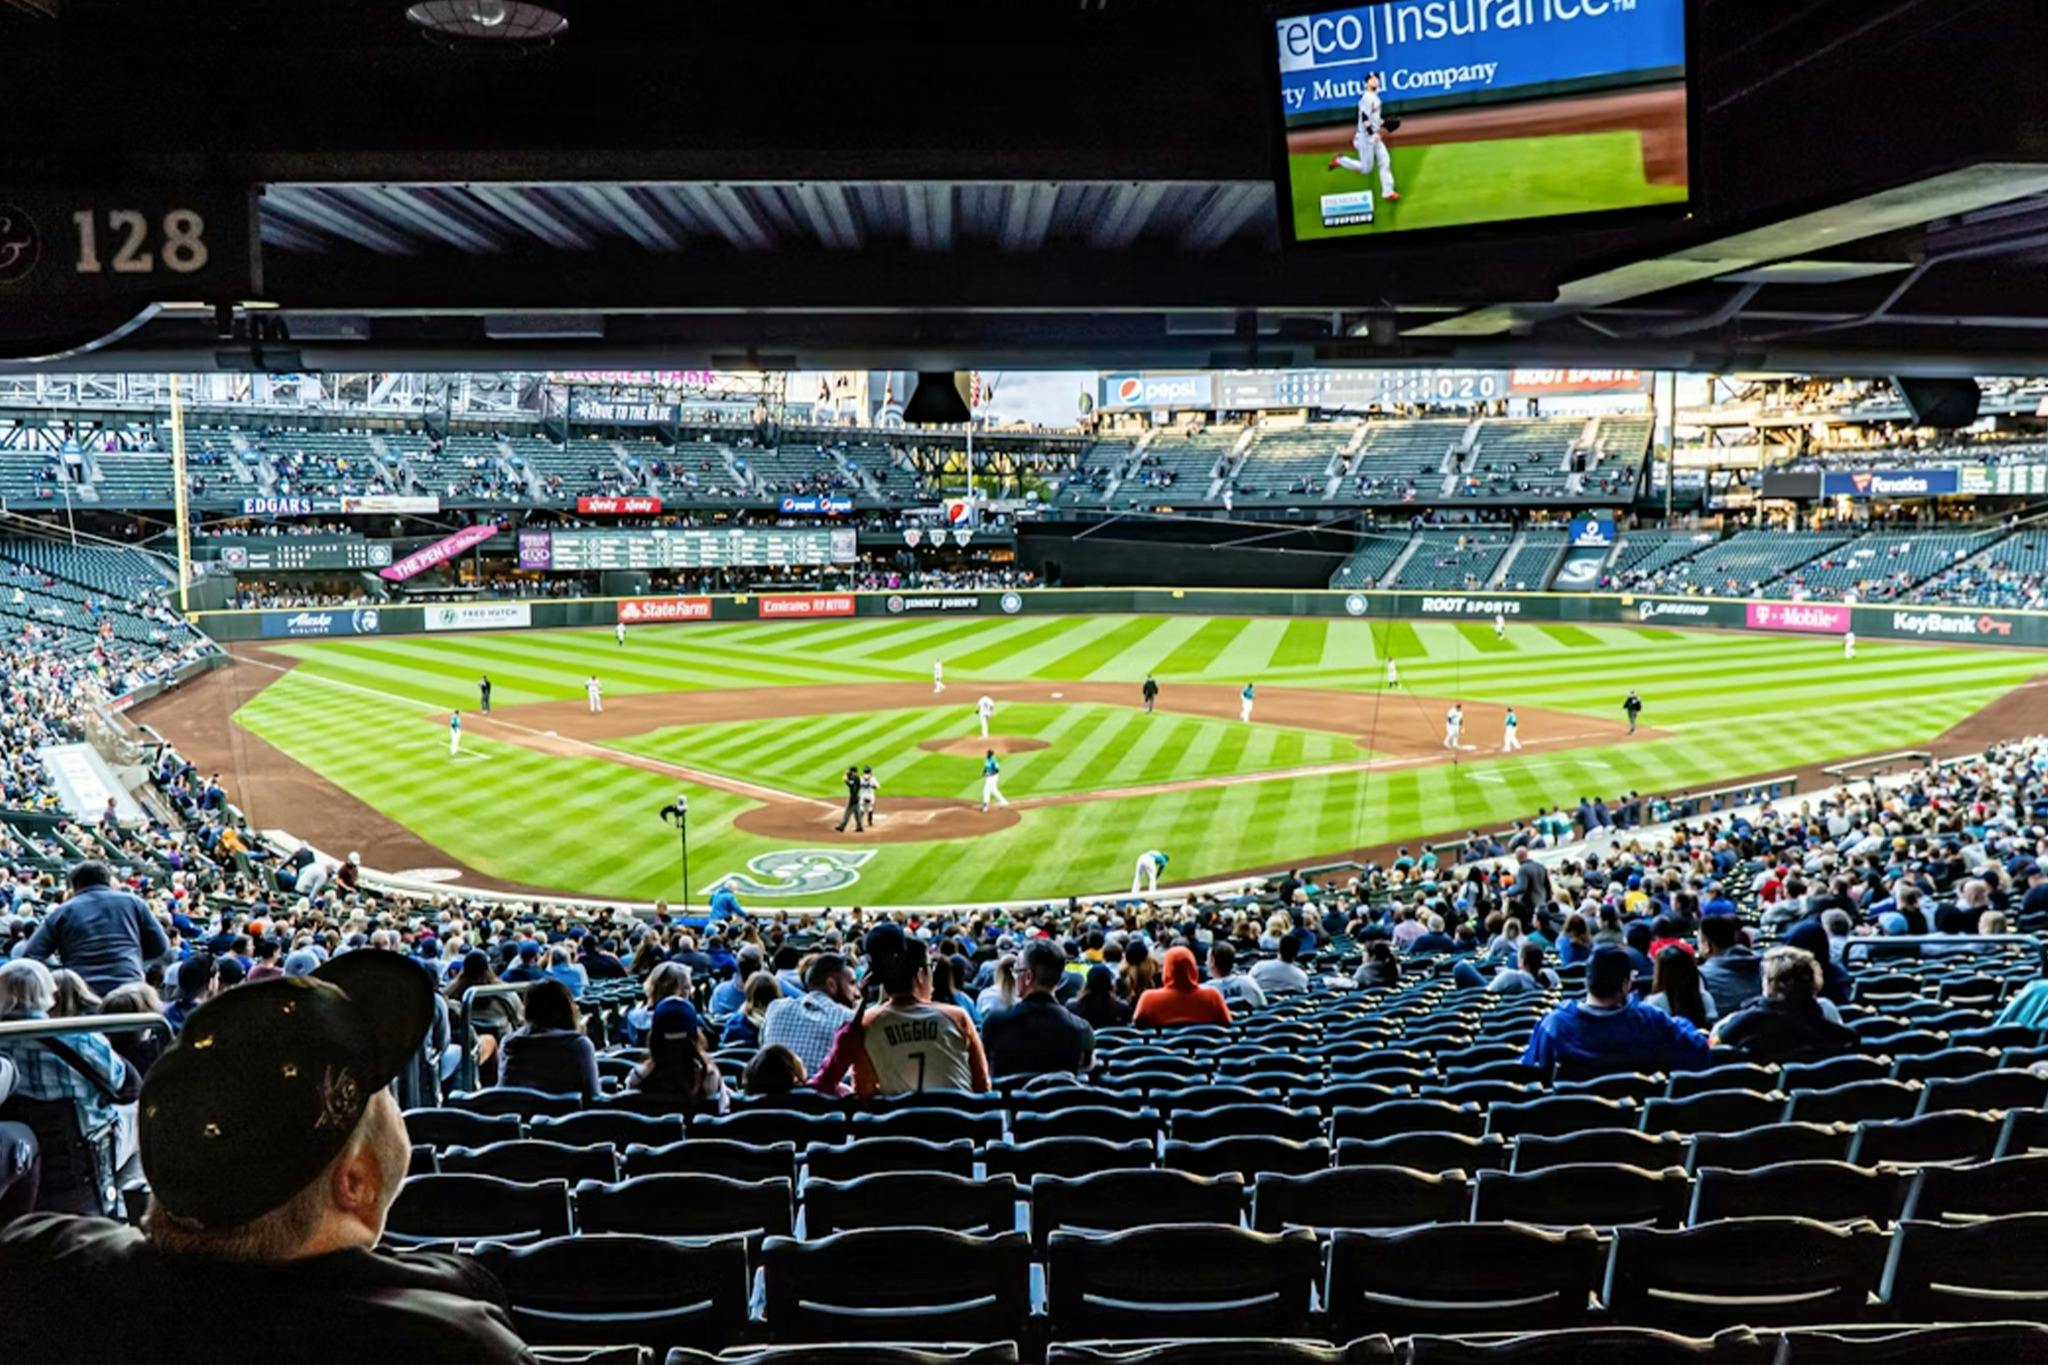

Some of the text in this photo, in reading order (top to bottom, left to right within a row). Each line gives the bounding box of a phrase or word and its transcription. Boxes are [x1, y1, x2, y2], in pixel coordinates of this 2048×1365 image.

[1276, 15, 1363, 56] eco
[1282, 61, 1498, 108] ty Mutul Company
[73, 209, 208, 273] 128
[1145, 379, 1196, 401] pepsi
[615, 403, 628, 420] TO
[629, 403, 646, 420] THE
[647, 402, 672, 421] BLUE
[1871, 476, 1928, 493] Fanatics
[243, 499, 312, 514] EDGARS
[763, 600, 810, 613] Emirates
[1422, 597, 1521, 614] ROOT SPORTS
[1893, 611, 1976, 634] KeyBank
[884, 1021, 938, 1046] BIGGIO
[908, 1051, 925, 1092] 7
